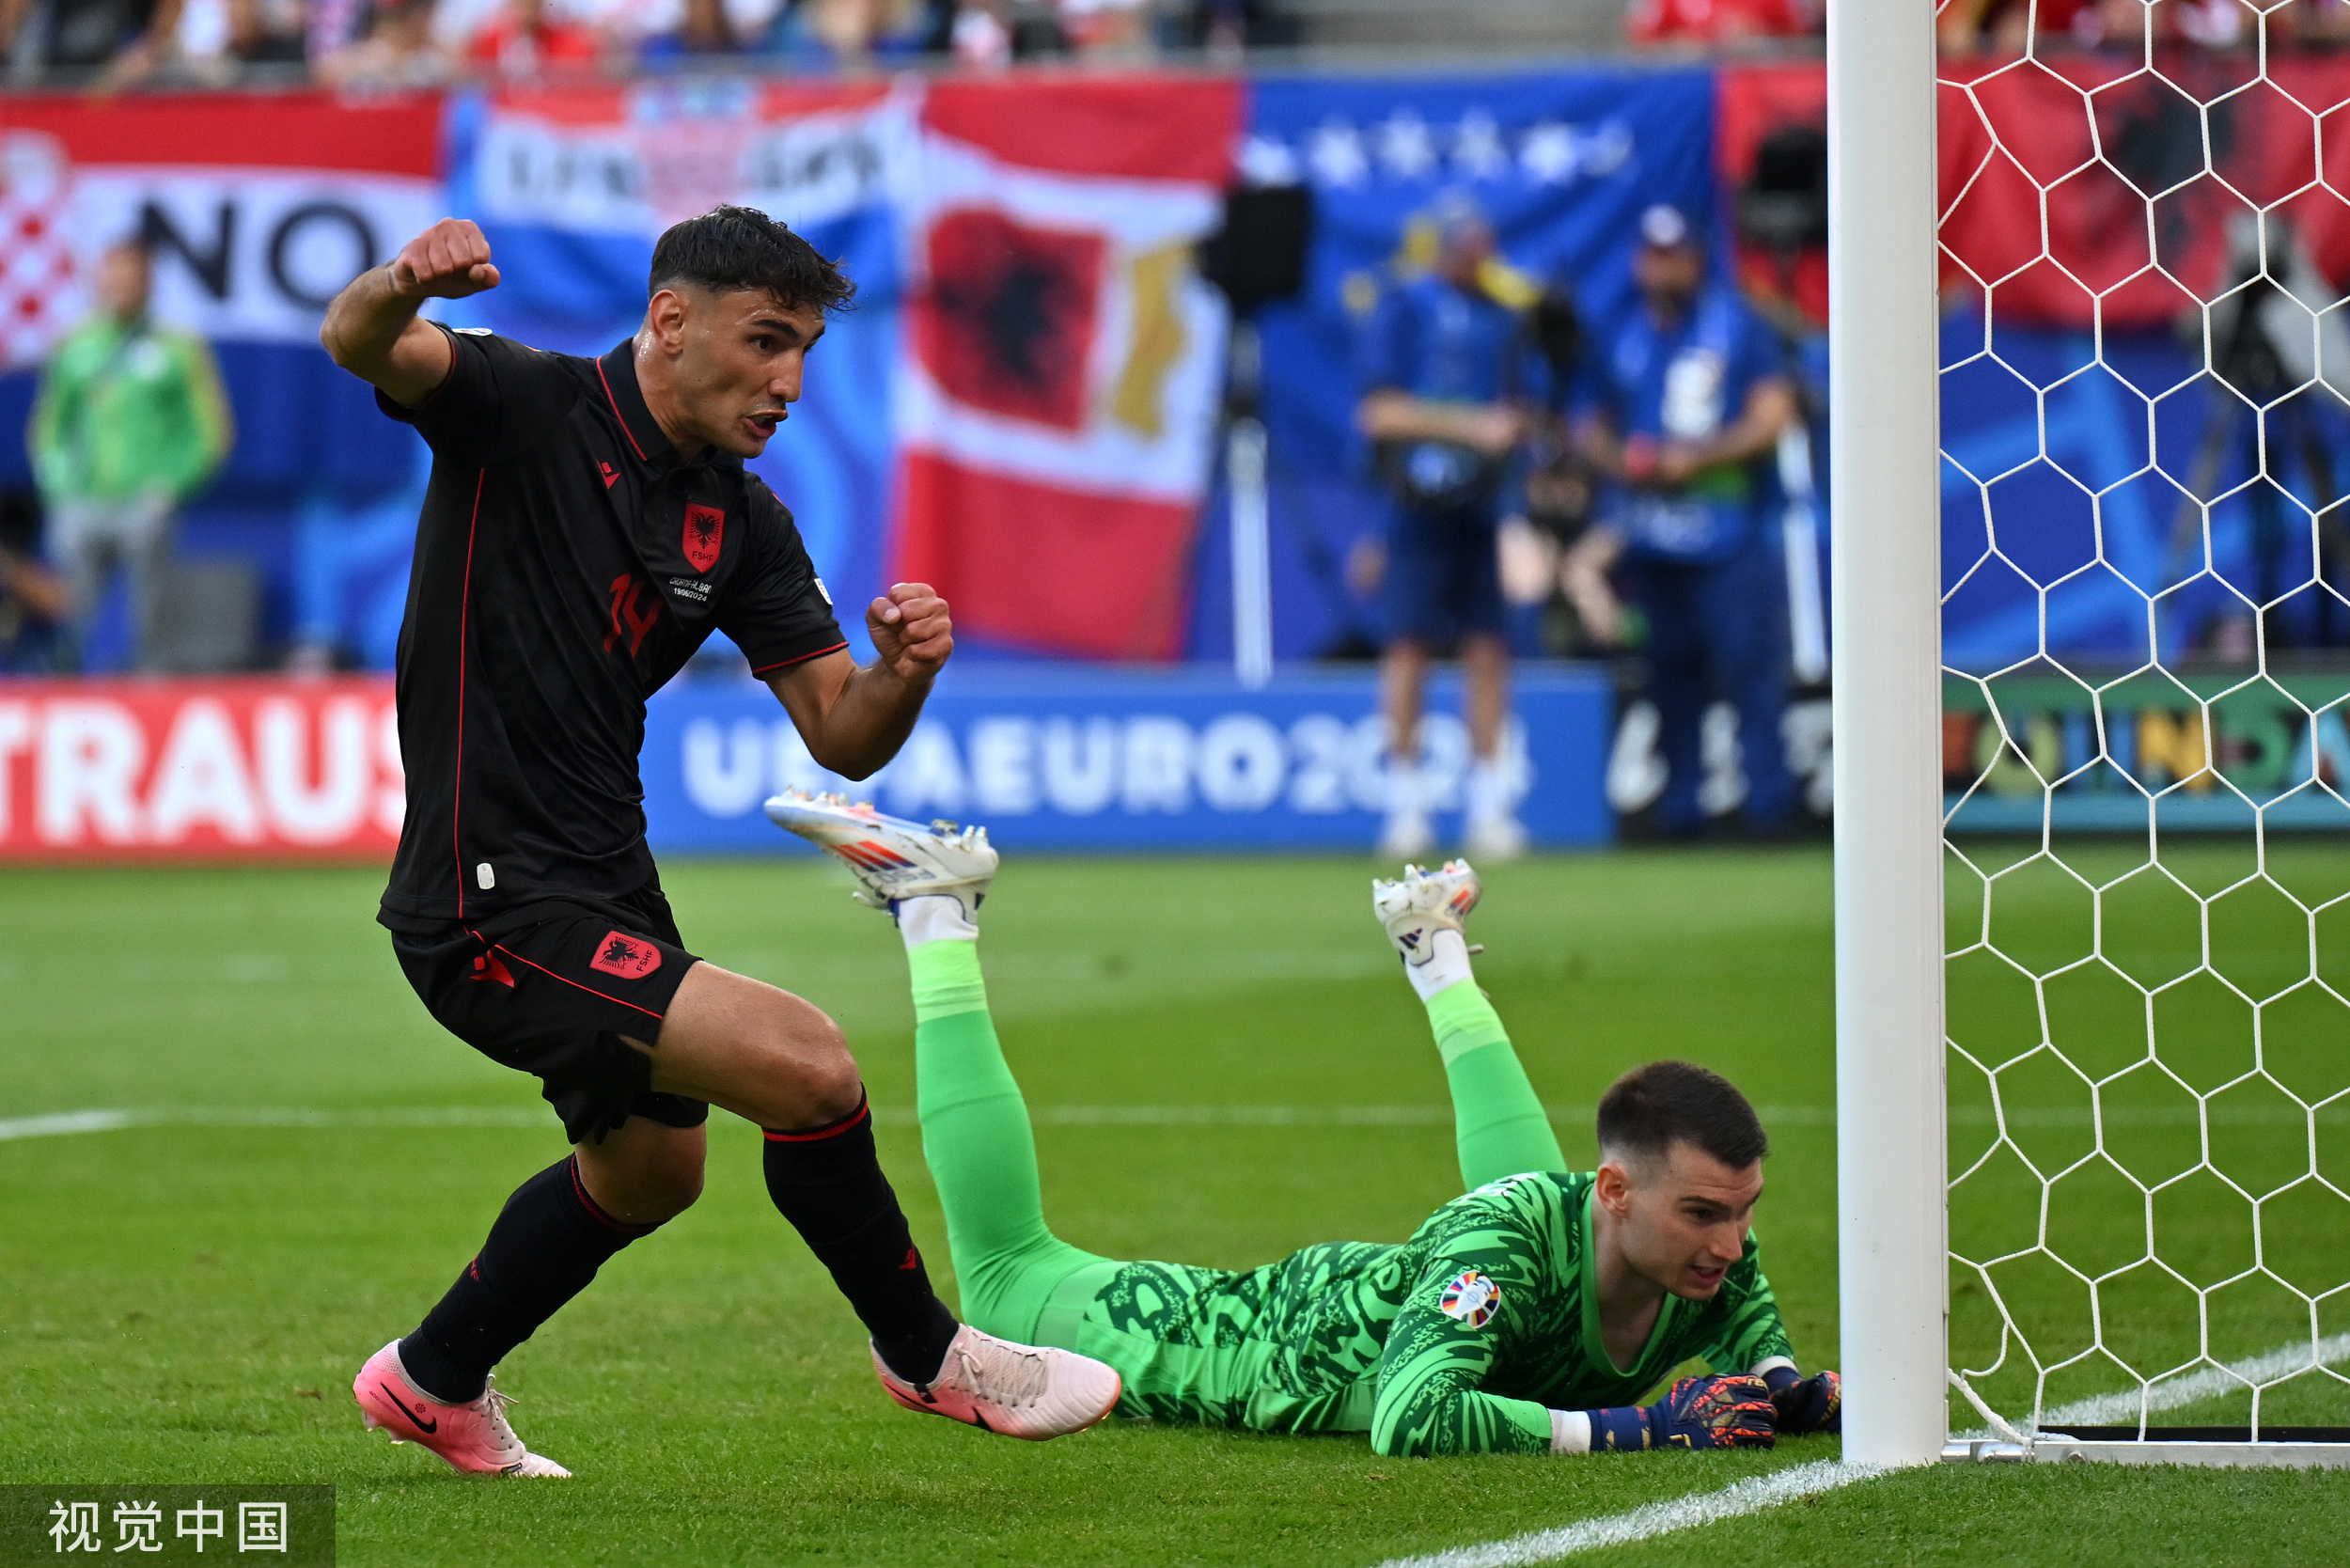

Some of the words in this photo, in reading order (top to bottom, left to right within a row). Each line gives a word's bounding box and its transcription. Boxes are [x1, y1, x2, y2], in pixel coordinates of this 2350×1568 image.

[139, 200, 376, 310] NO
[692, 550, 714, 562] FSHF
[603, 572, 662, 658] 14
[635, 949, 653, 972] FSHF
